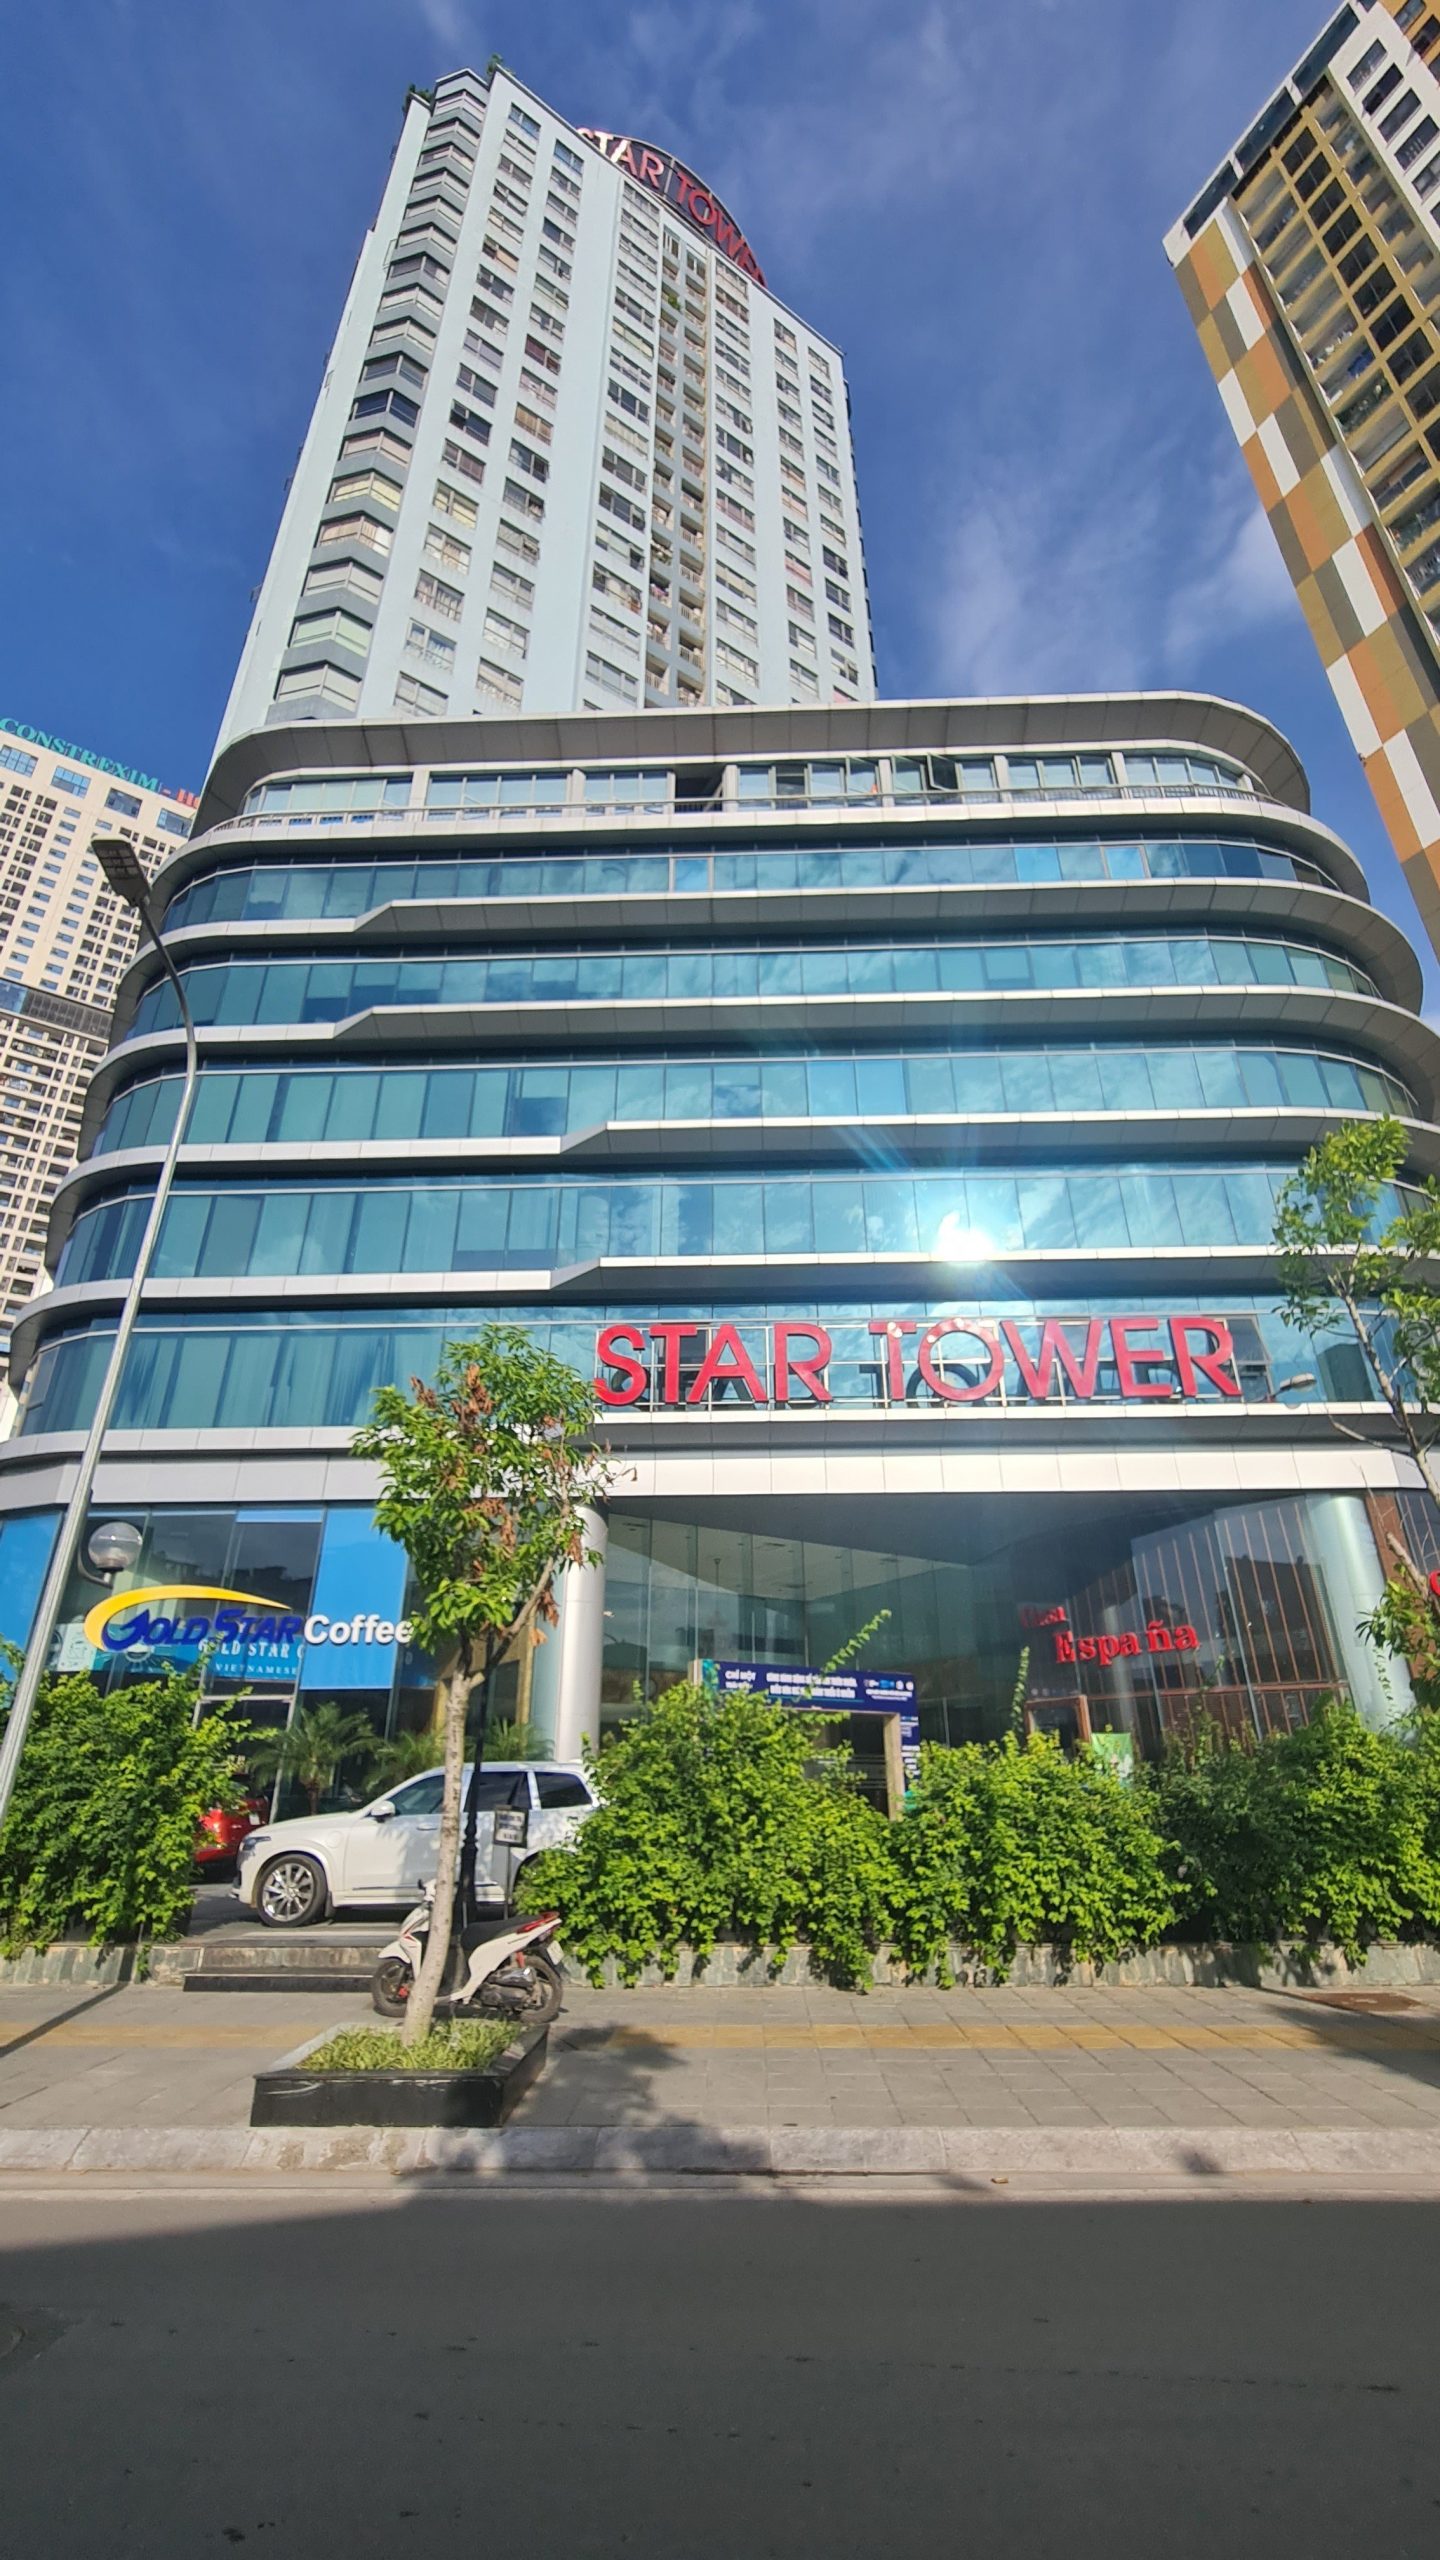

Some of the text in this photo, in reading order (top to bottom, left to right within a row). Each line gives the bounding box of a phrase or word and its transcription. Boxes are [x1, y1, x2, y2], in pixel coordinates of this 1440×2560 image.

[0, 717, 159, 793] CONSTREXIM
[593, 1317, 1242, 1405] STAR TOWER
[198, 1638, 241, 1655] GLD
[248, 1641, 290, 1659] STAR
[303, 1614, 414, 1645] Coffee
[1055, 1619, 1200, 1666] España
